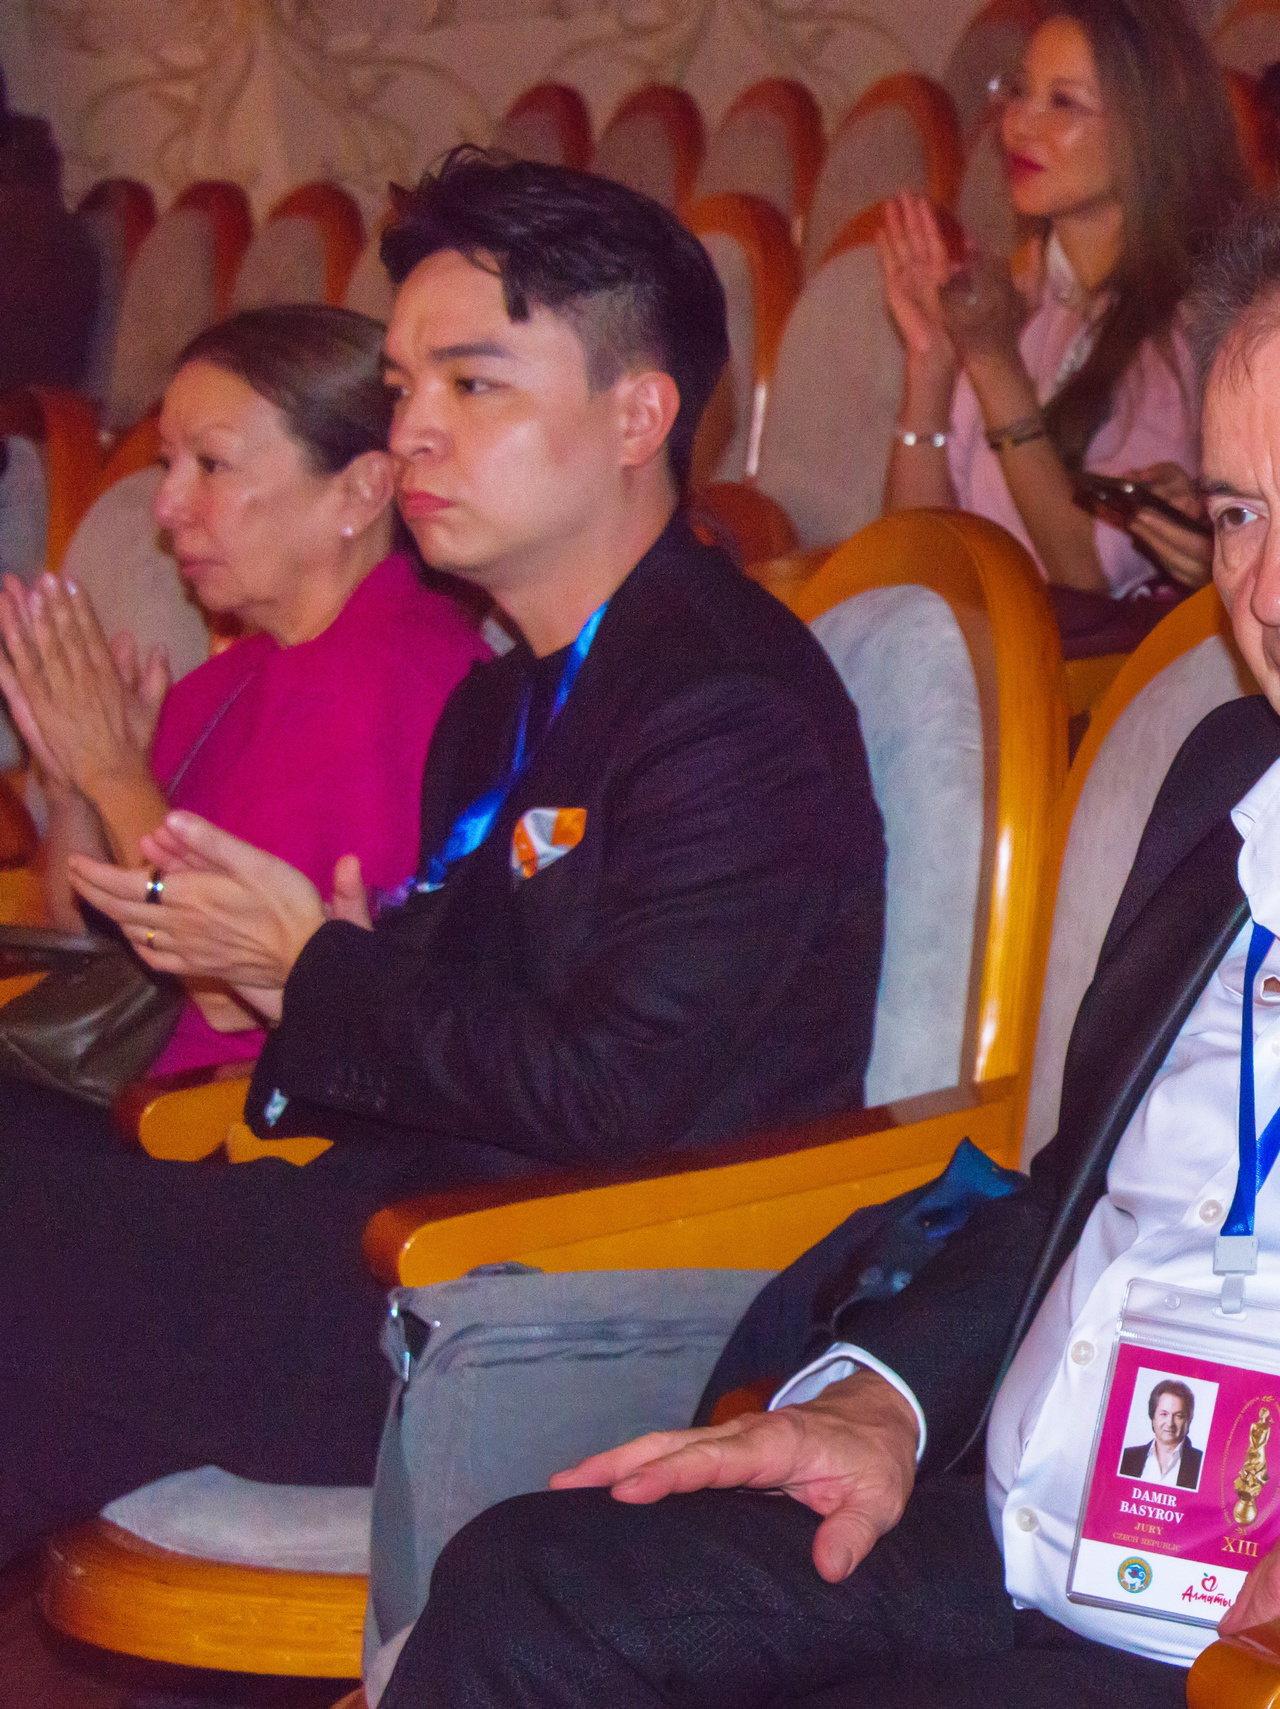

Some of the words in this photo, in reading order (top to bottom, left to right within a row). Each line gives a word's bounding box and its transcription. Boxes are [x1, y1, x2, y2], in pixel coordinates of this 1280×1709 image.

[1132, 1487, 1177, 1507] DAMIR
[1120, 1501, 1185, 1524] BASYROV
[1134, 1522, 1164, 1535] JURY
[1113, 1532, 1139, 1543] CZECH
[1141, 1537, 1181, 1551] REPUBLIC
[1221, 1536, 1258, 1557] XIII
[1181, 1585, 1232, 1607] Алматы
